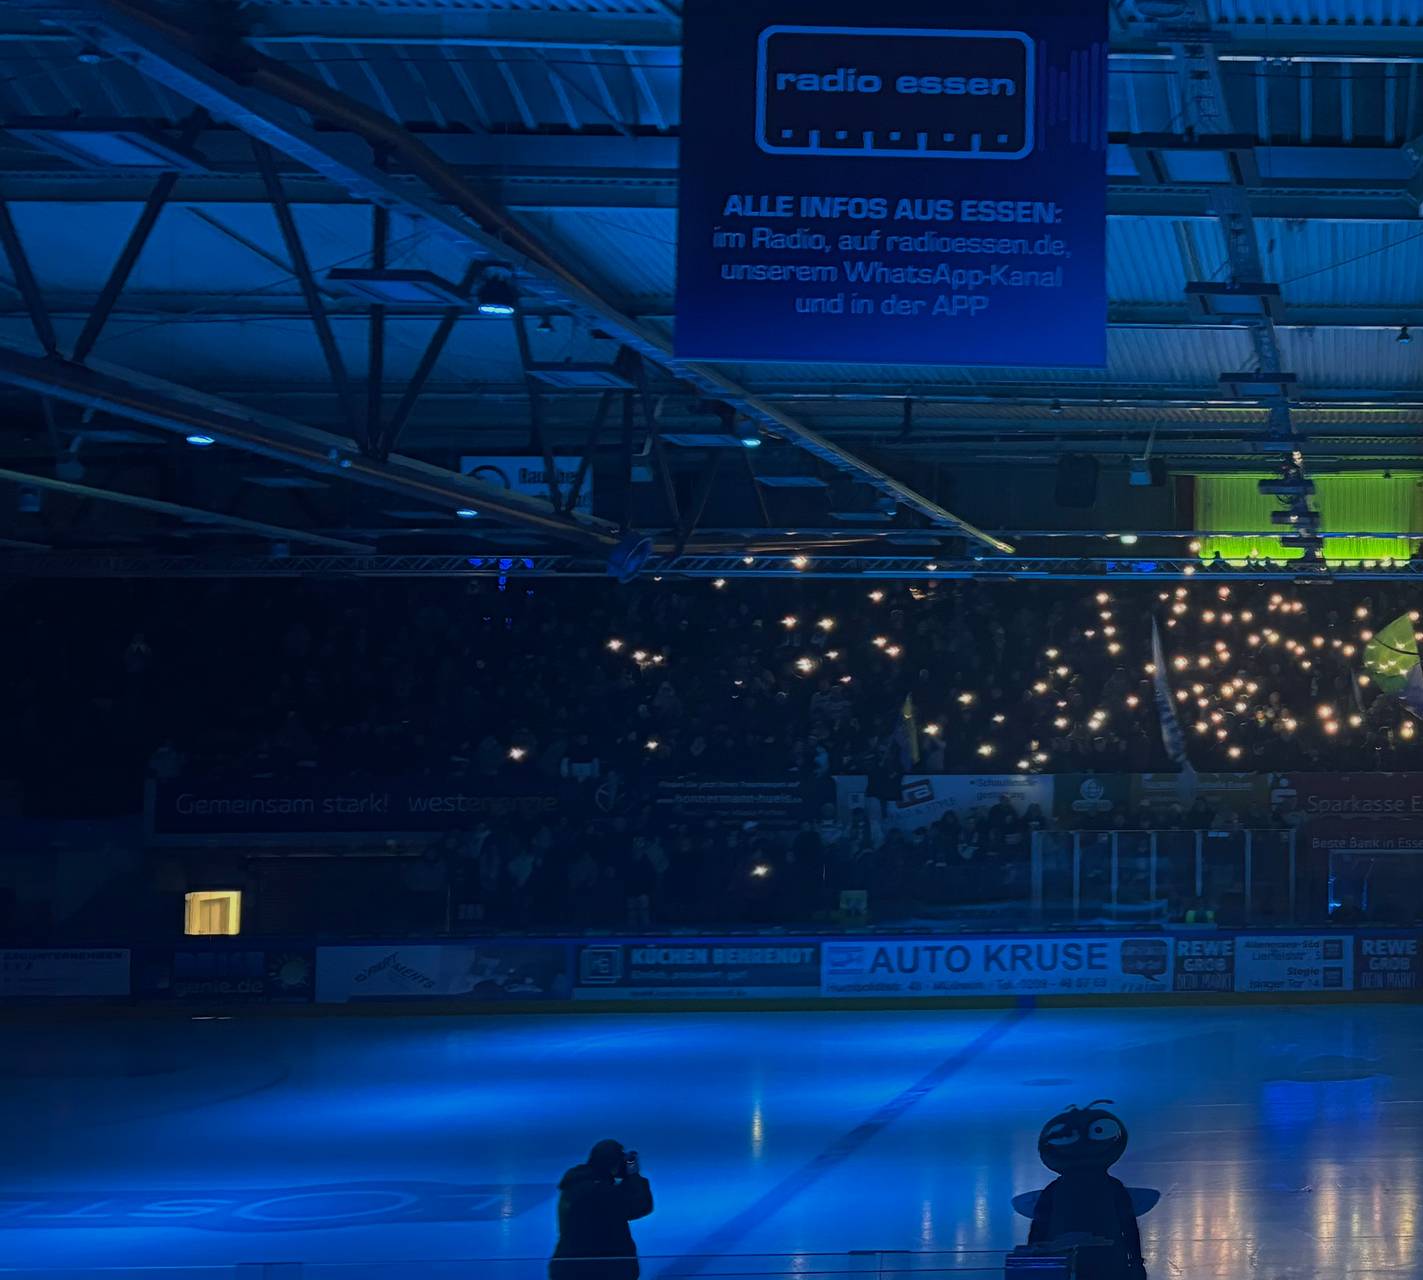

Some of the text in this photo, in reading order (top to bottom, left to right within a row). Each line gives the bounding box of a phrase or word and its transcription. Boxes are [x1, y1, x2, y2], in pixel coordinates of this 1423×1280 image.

[776, 67, 1017, 97] radio essen
[723, 194, 1062, 225] ALLE INFOS AUS ESSEN:
[713, 226, 1071, 259] im Radio, auf radioessen.de,
[720, 261, 1062, 292] unserem WhatsApp-Kanal
[794, 293, 990, 318] und in der APP
[175, 793, 315, 815] Gemeinsam
[322, 792, 389, 814] stark!
[1306, 794, 1405, 814] Sparkasse
[869, 944, 972, 975] AUTO
[983, 942, 1109, 972] KRUSE
[1176, 939, 1233, 957] REWE
[1360, 938, 1417, 956] REWE
